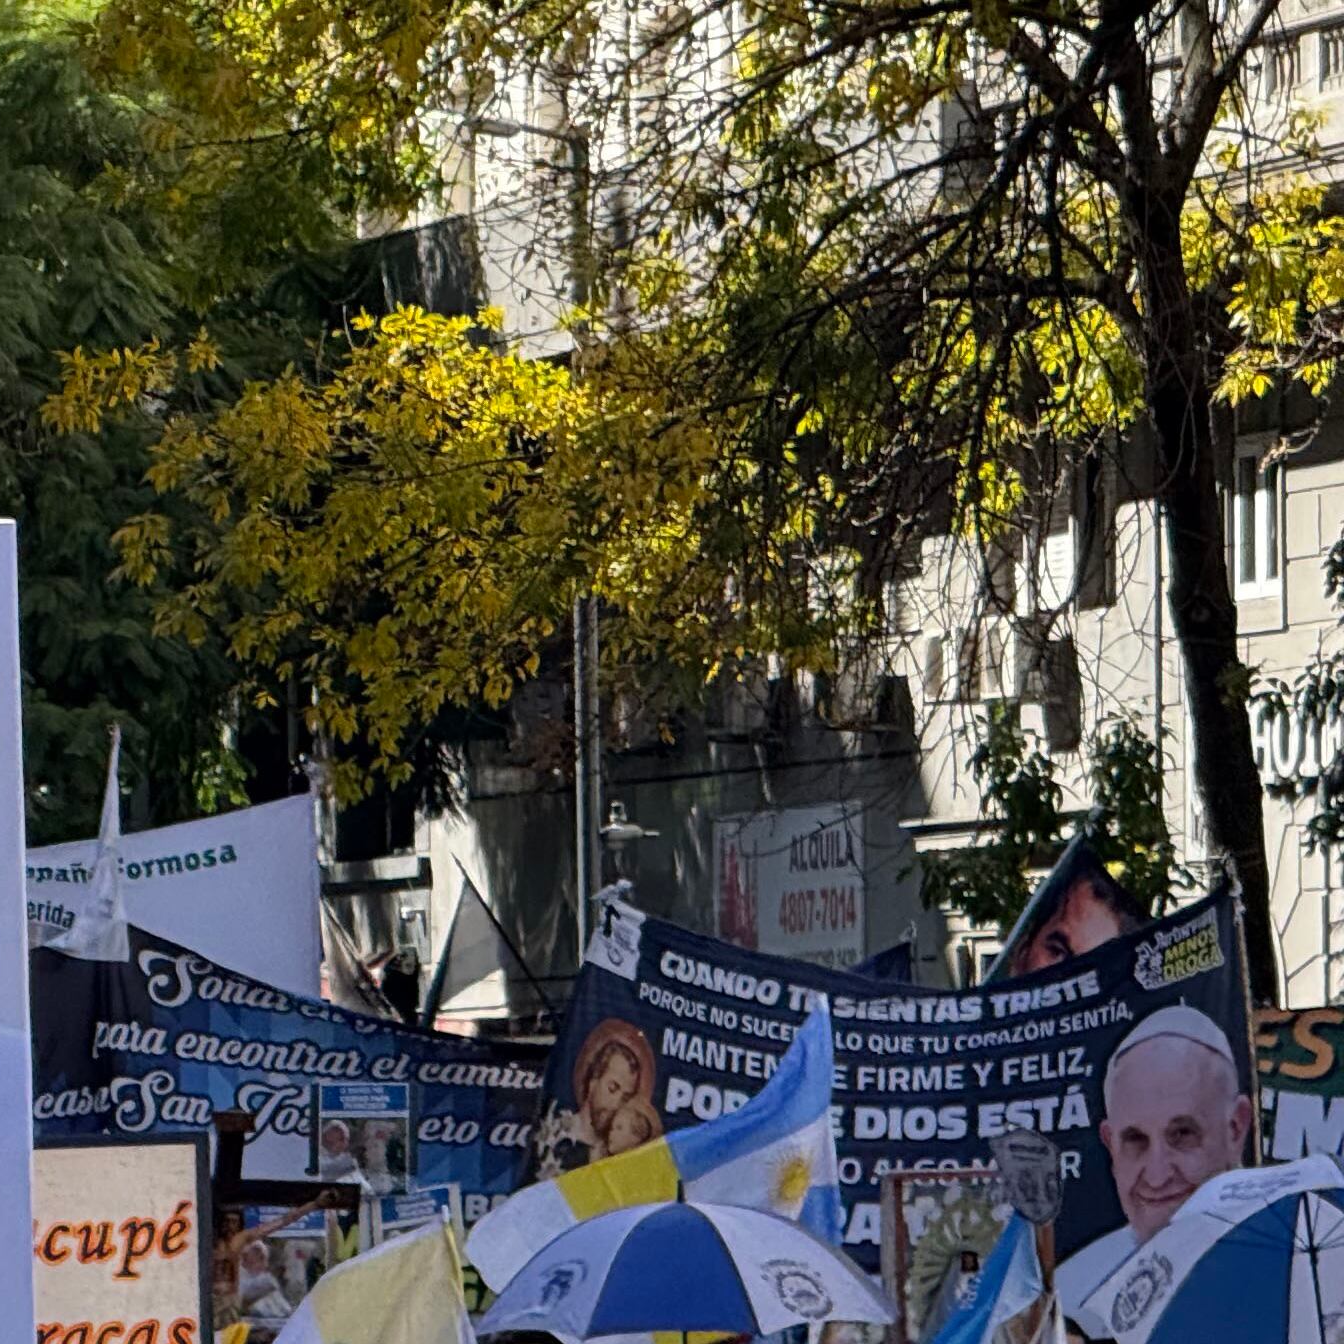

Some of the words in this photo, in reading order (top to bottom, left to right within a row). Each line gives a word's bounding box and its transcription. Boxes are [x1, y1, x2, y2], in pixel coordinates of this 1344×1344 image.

[790, 830, 855, 873] ALQUILA
[779, 886, 857, 935] 4807-7014
[661, 951, 781, 1006] CUANDO
[833, 995, 983, 1023] SIENTAS
[990, 971, 1101, 1016] TRISTE
[639, 982, 708, 1021] PORQUE
[710, 1006, 738, 1030] NO
[835, 1031, 862, 1051] LO
[868, 1033, 914, 1055] QUE
[920, 1036, 949, 1054] TU
[955, 1018, 1056, 1050] CORAZÓN
[93, 1019, 168, 1058] para
[175, 1026, 364, 1077] encontrar
[372, 1054, 410, 1081] el
[857, 1063, 965, 1092] FIRME
[973, 1062, 994, 1088] Y
[109, 1070, 212, 1133] San
[854, 1105, 968, 1141] DIOS
[978, 1084, 1091, 1140] ESTÁ
[33, 1200, 194, 1281] cupé
